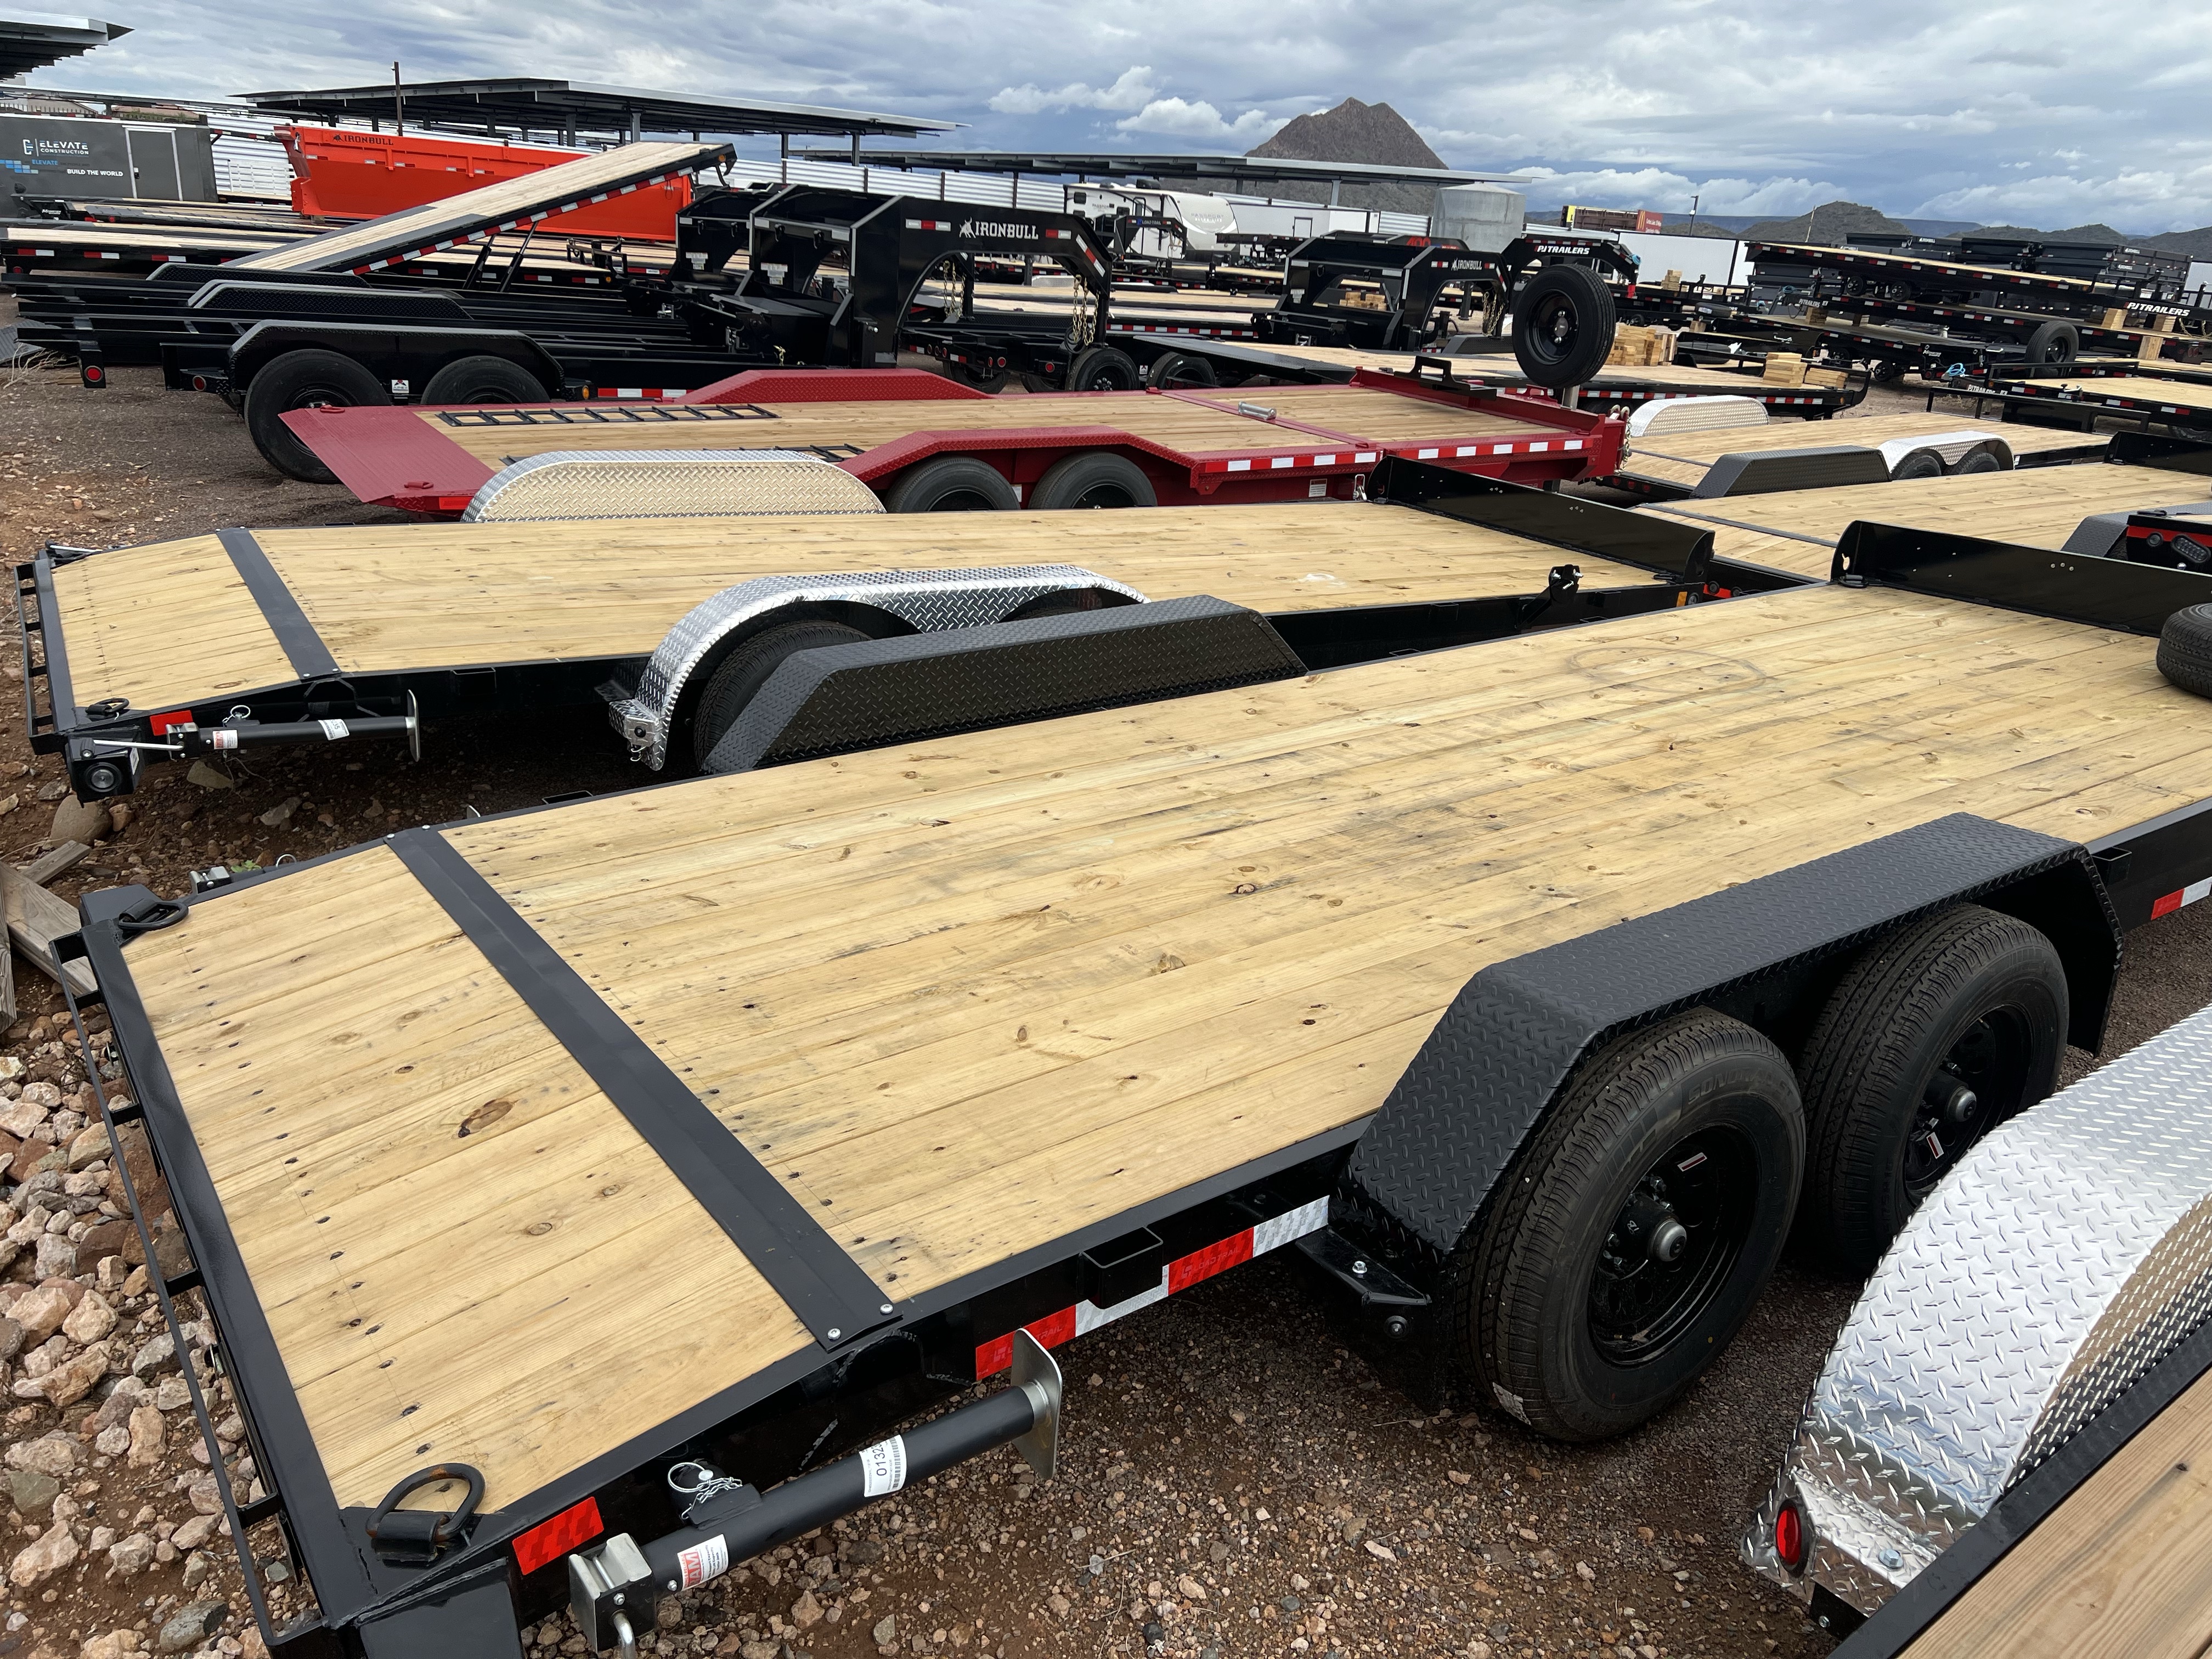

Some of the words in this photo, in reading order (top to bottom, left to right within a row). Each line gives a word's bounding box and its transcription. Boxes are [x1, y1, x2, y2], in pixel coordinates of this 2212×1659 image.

[40, 140, 88, 150] ELEVATE
[344, 135, 393, 145] IRONBULL
[975, 221, 1039, 240] IRONBULL
[1458, 259, 1482, 270] IRONBULL
